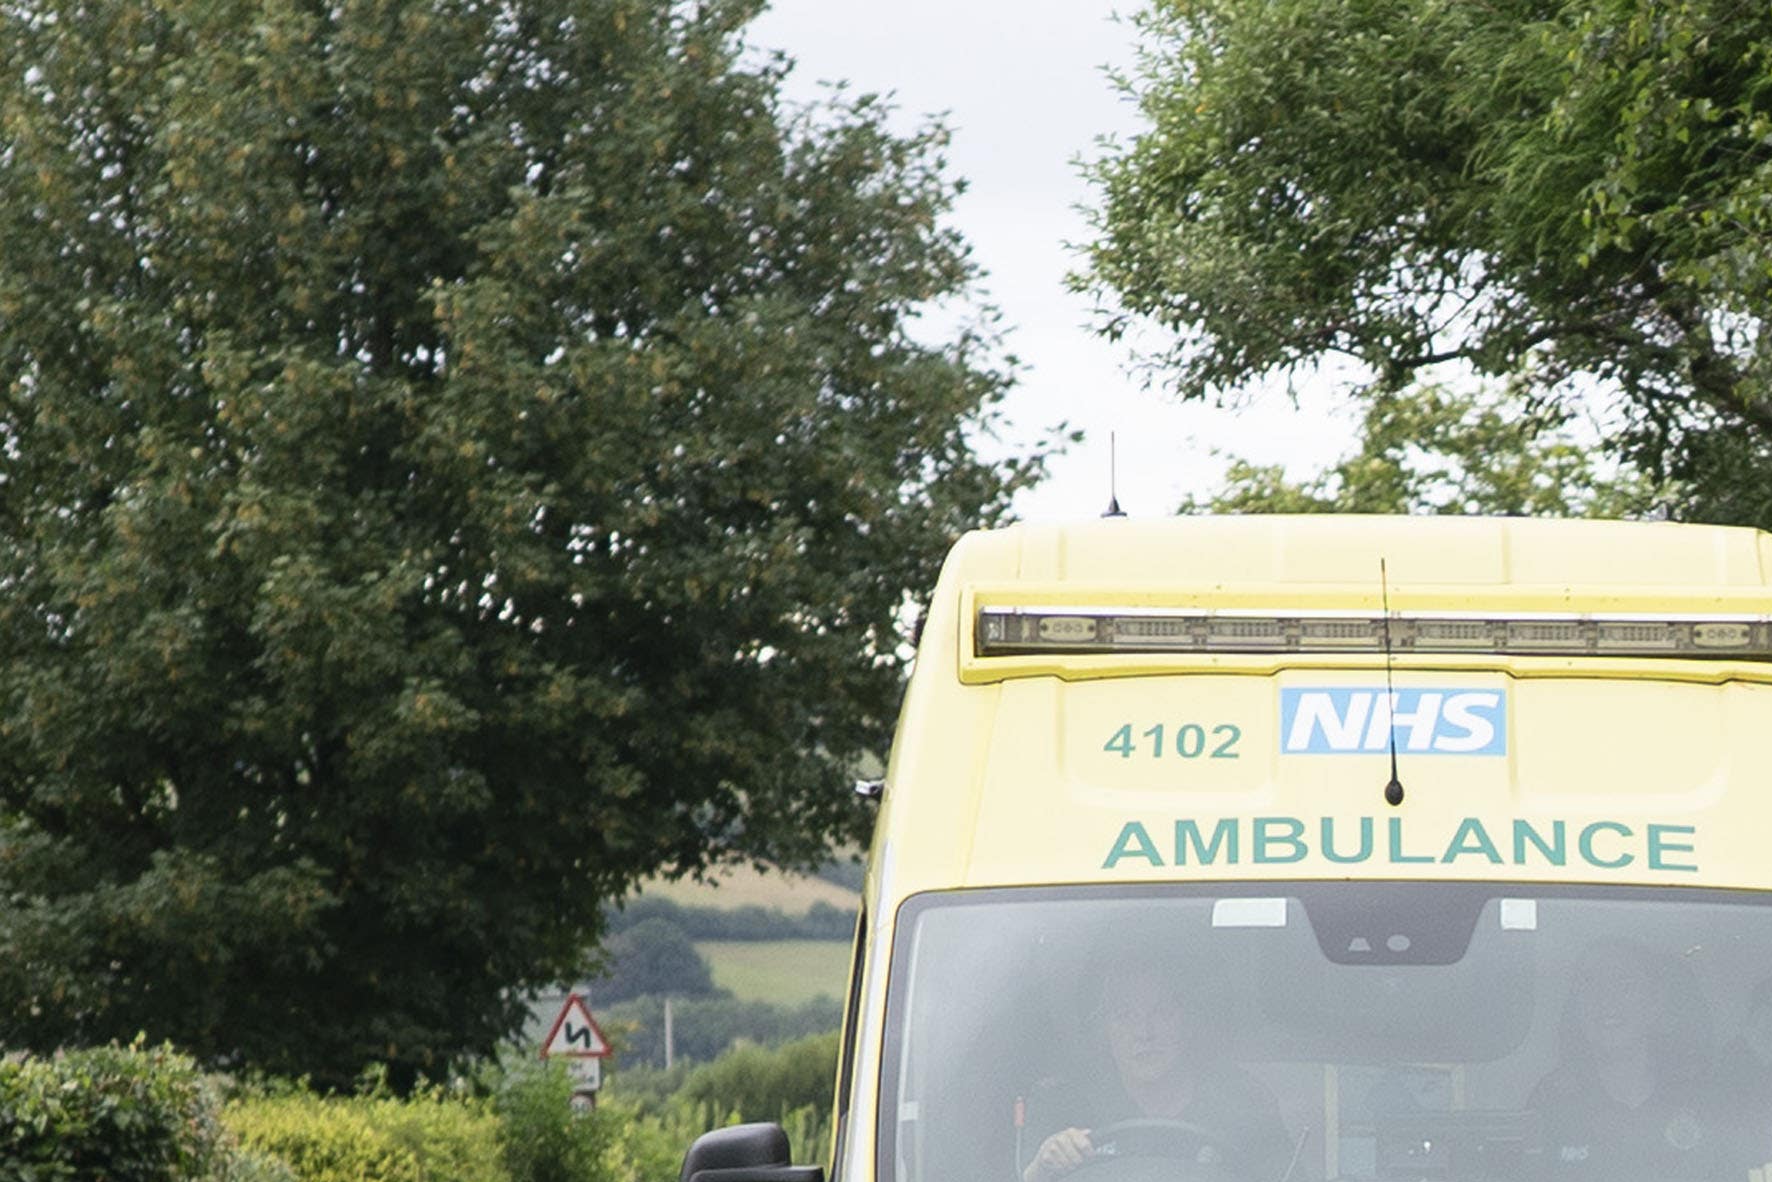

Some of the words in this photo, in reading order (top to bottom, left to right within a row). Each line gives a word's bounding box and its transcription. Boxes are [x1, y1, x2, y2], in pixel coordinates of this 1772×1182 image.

[1103, 723, 1241, 758] 4102
[1286, 692, 1499, 751] NHS
[1101, 816, 1699, 872] AMBULANCE
